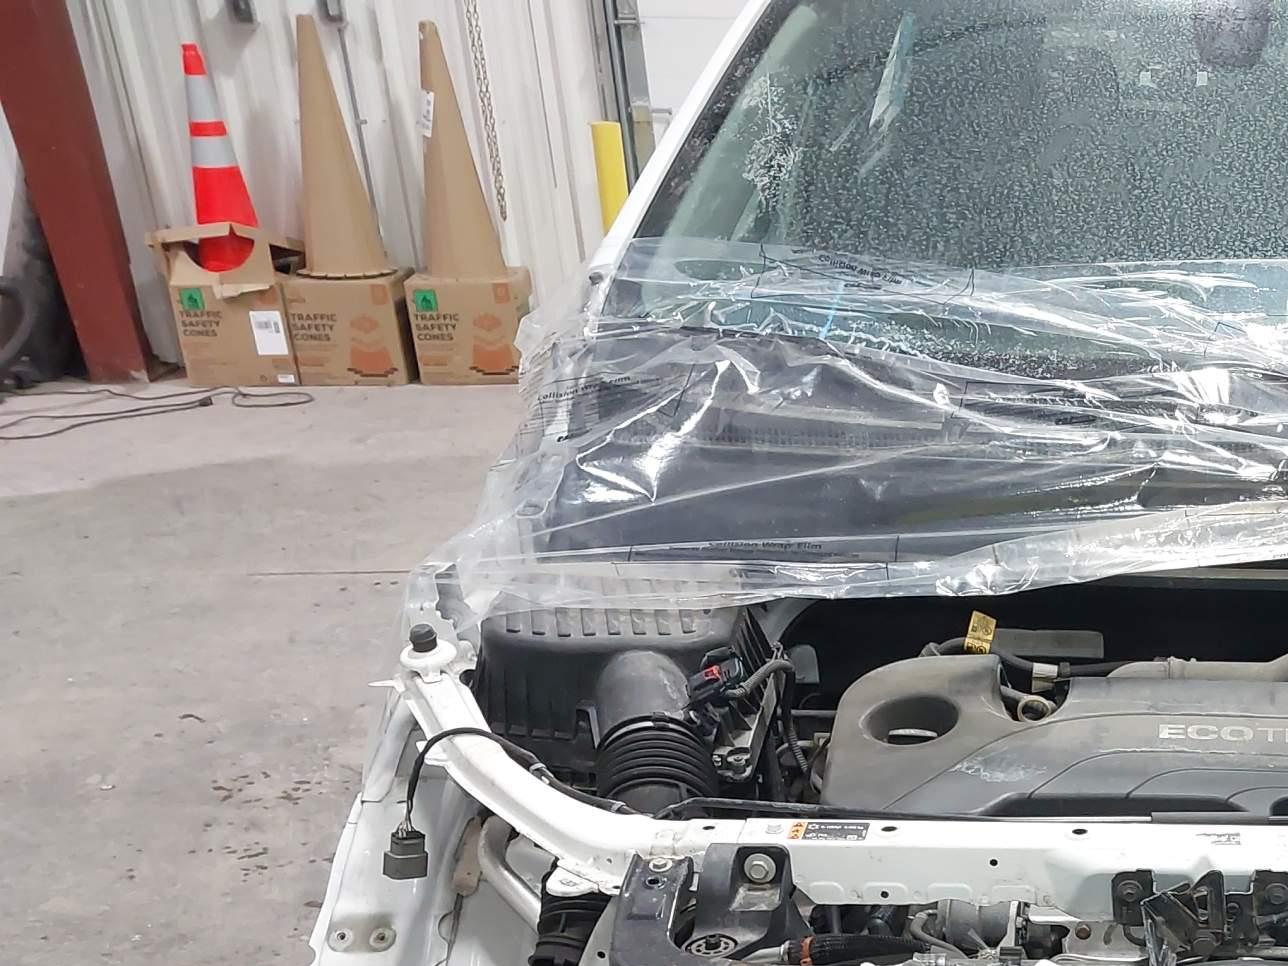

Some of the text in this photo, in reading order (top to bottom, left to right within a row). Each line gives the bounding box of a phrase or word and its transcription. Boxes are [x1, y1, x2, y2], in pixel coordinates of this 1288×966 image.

[179, 310, 222, 319] TRAFFIC
[291, 312, 336, 321] TRAFFIC
[414, 313, 459, 321] TRAFFIC
[181, 320, 220, 328] SAFETY
[292, 322, 335, 331] SAFETY
[416, 322, 457, 331] SAFETY
[183, 328, 218, 337] CONES
[294, 332, 331, 341] CONES
[417, 332, 454, 341] CONES
